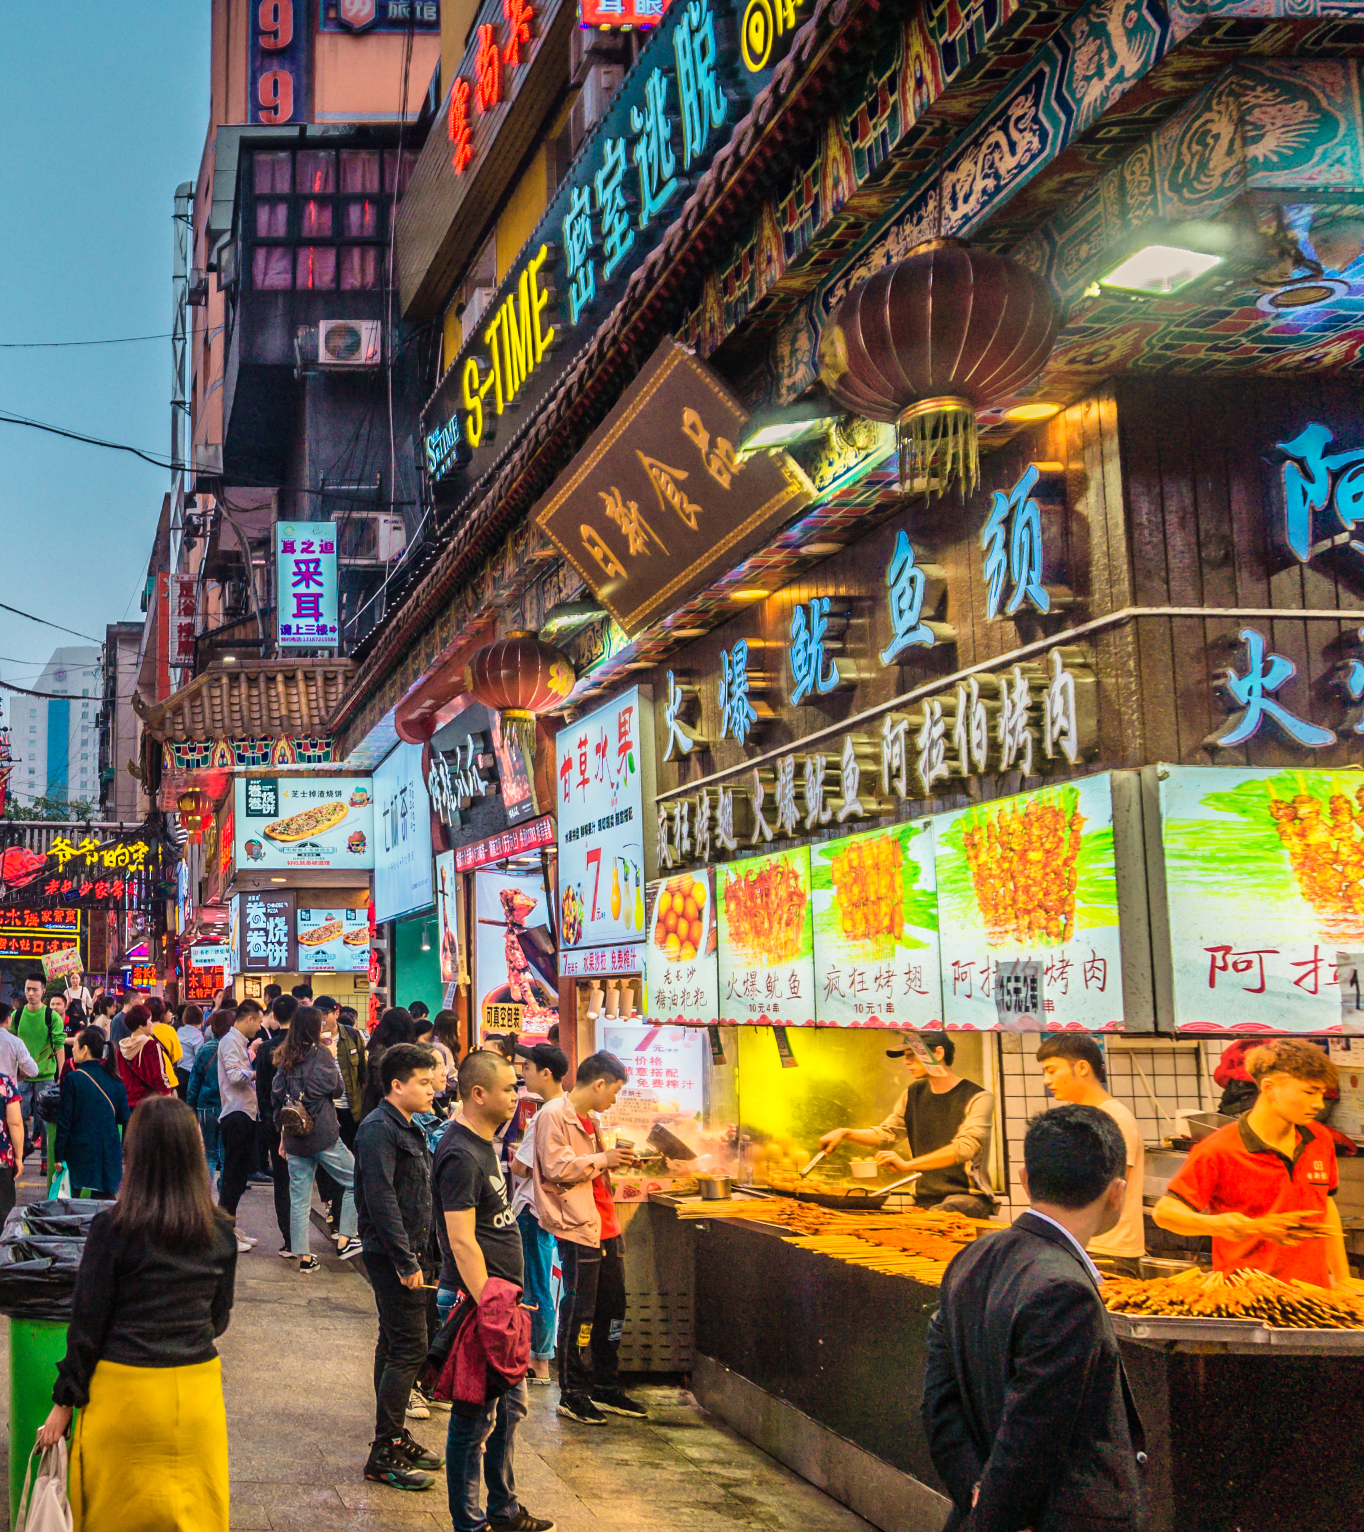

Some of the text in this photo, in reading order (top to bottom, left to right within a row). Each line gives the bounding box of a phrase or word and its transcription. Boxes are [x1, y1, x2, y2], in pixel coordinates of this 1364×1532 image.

[564, 0, 728, 325] 密室逃脱
[462, 244, 555, 447] S-TIME
[280, 538, 335, 555] 耳之道
[291, 557, 324, 622] 采耳
[662, 463, 1050, 762] 火爆鱿鱼须
[279, 624, 328, 636] 请上三楼
[881, 651, 1078, 800] 阿拉伯烤肉
[560, 705, 634, 804] 甘草水果
[261, 791, 276, 814] 烧饼
[291, 789, 343, 798] 芝士掉渣烧饼
[751, 733, 864, 844] 火爆鱿鱼
[586, 847, 602, 921] 7
[266, 916, 288, 967] 烧饼
[583, 952, 607, 973] 水果沙拉
[611, 948, 637, 971] 免费榨汁
[663, 965, 697, 985] 老长沙
[726, 968, 803, 1001] 火爆鱿鱼
[822, 961, 930, 1003] 疯狂烤翅
[654, 986, 708, 1012] 糖油粑粑
[748, 1003, 780, 1014] 10元4串
[853, 1002, 895, 1014] 10元1串
[486, 1005, 521, 1029] 可真空包装
[636, 1077, 695, 1090] 免费榨汁
